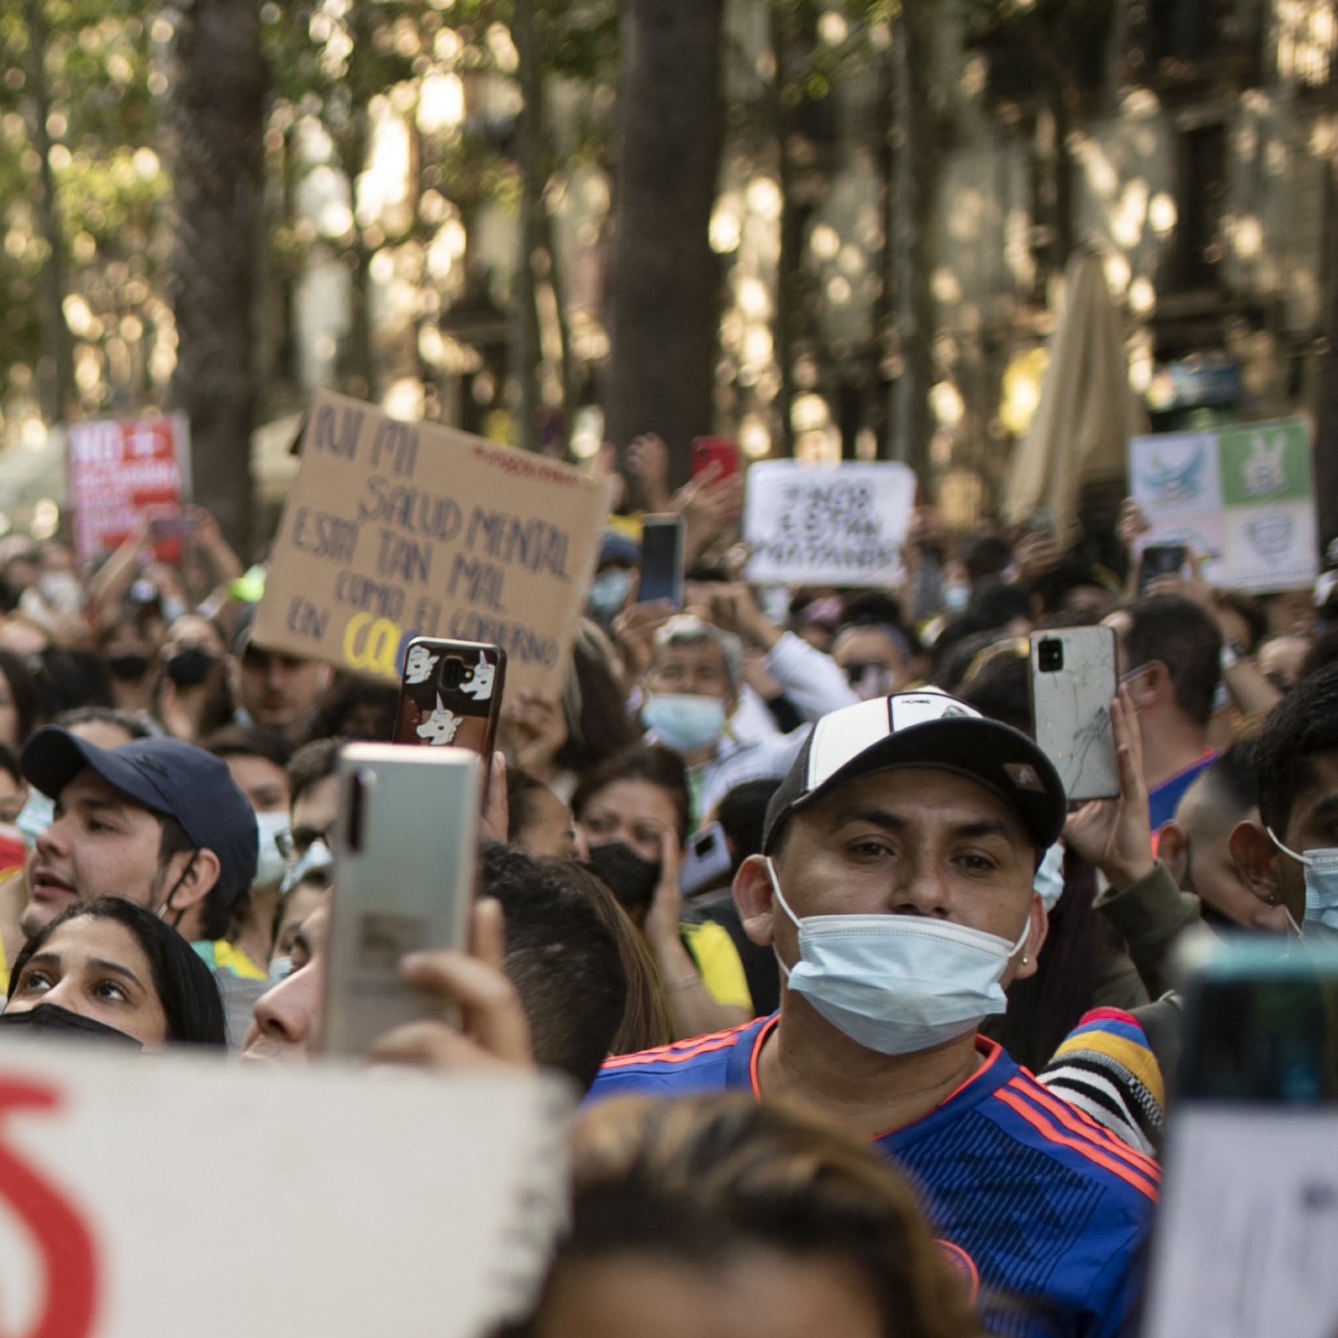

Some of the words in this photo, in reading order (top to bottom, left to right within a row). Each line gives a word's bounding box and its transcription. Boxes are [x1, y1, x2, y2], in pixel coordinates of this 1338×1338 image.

[315, 403, 365, 461] NI
[371, 418, 419, 479] MI
[357, 475, 463, 543] SALUD
[468, 506, 572, 582] MENTAL
[335, 570, 405, 622] COMO
[378, 527, 432, 585] TAN
[447, 552, 507, 616] MAL
[287, 596, 330, 642] EN
